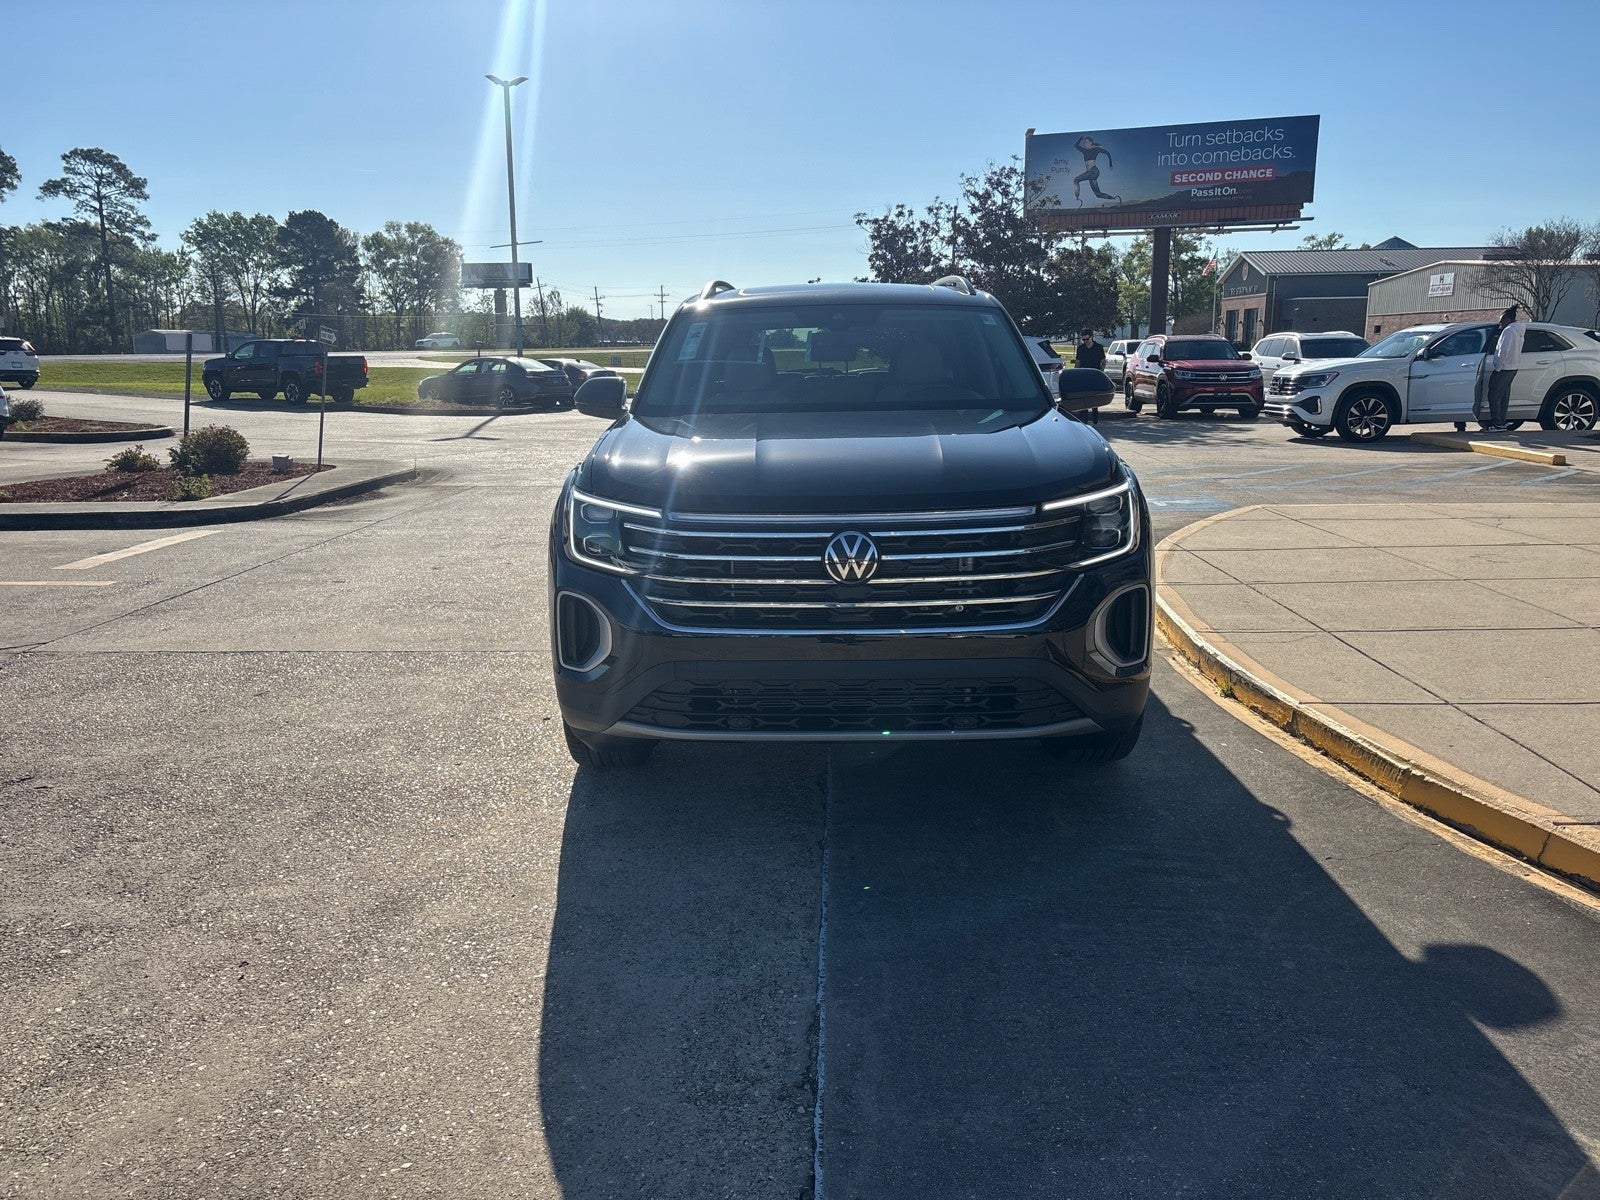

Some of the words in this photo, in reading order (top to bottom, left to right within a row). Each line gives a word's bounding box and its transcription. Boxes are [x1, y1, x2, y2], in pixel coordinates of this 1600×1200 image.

[1166, 132, 1202, 148] Turn
[1205, 126, 1285, 146] setbacks
[1157, 151, 1188, 166] into
[1191, 144, 1296, 164] comebacks.
[1174, 172, 1222, 183] SECOND
[1224, 168, 1273, 180] CHANCE
